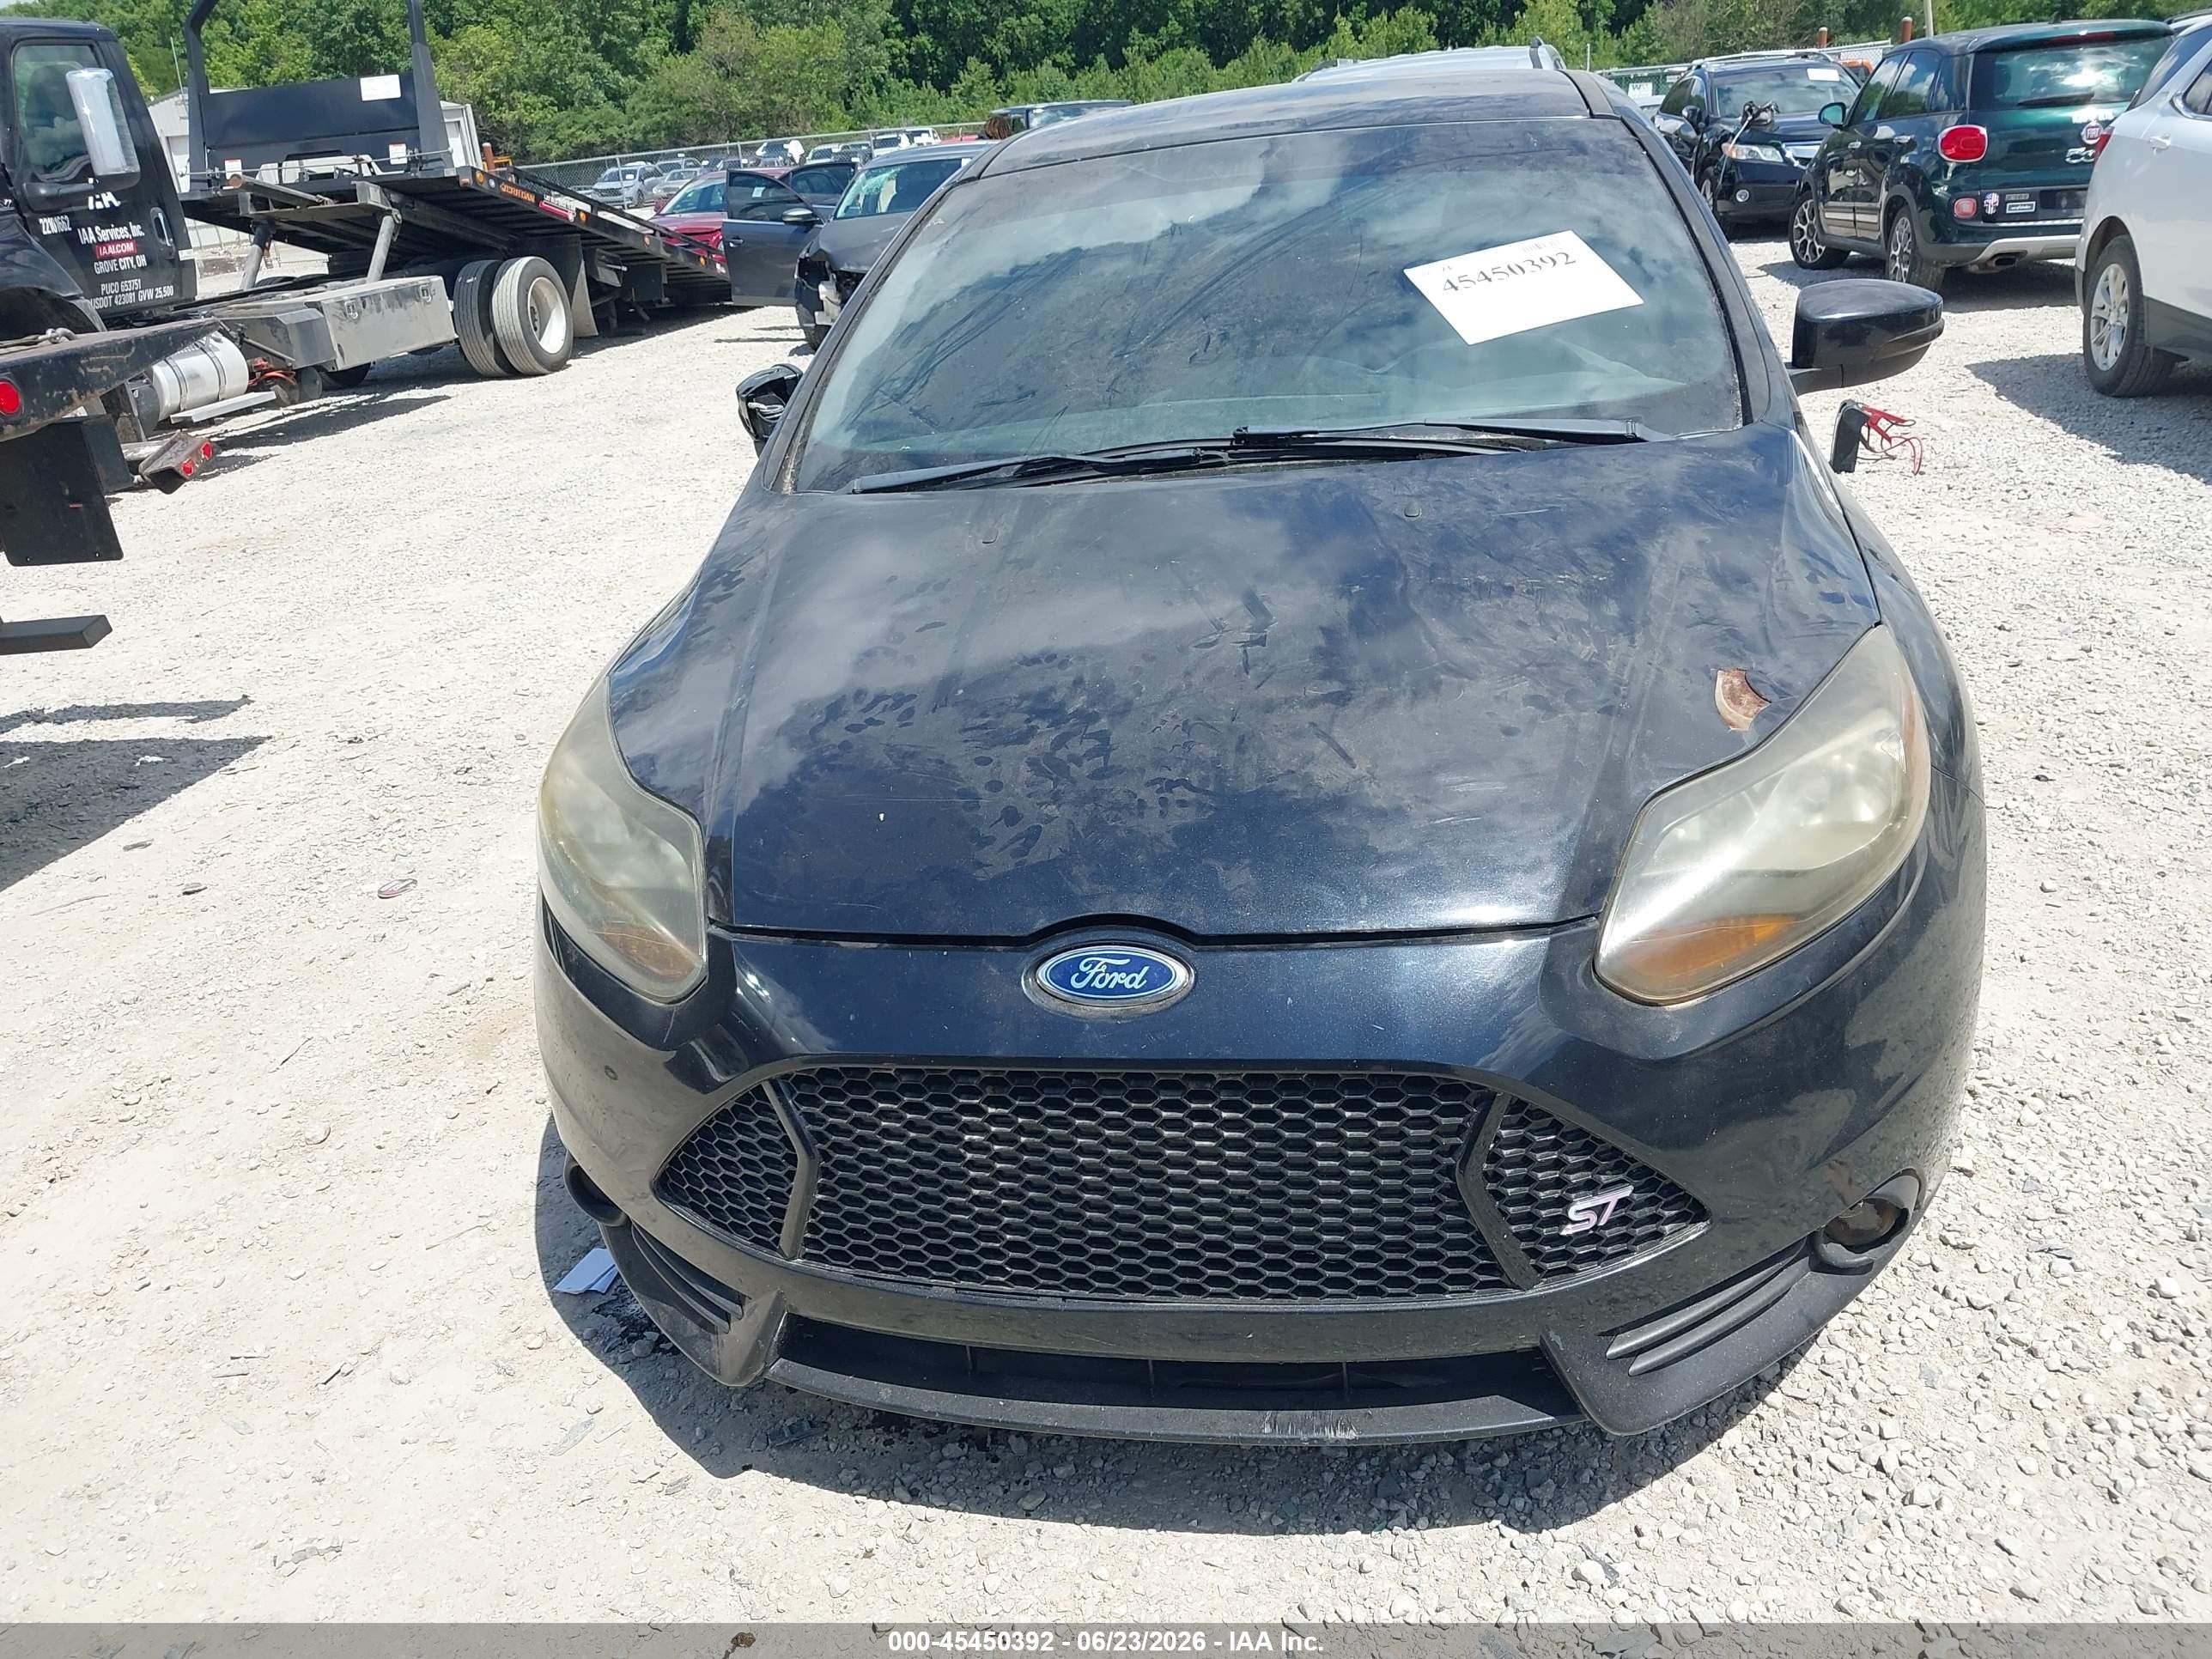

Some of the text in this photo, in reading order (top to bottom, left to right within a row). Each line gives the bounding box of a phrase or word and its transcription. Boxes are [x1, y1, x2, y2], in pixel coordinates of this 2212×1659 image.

[77, 222, 145, 245] IAA Services, Inc.
[94, 254, 147, 275] GROVE CITY, OH
[1443, 252, 1577, 293] 45450392
[90, 295, 112, 310] USDOT
[137, 289, 154, 301] GVW
[155, 285, 173, 299] 25,500
[100, 283, 119, 295] PUCO
[1070, 957, 1150, 988] Ford
[1559, 1184, 1634, 1236] ST
